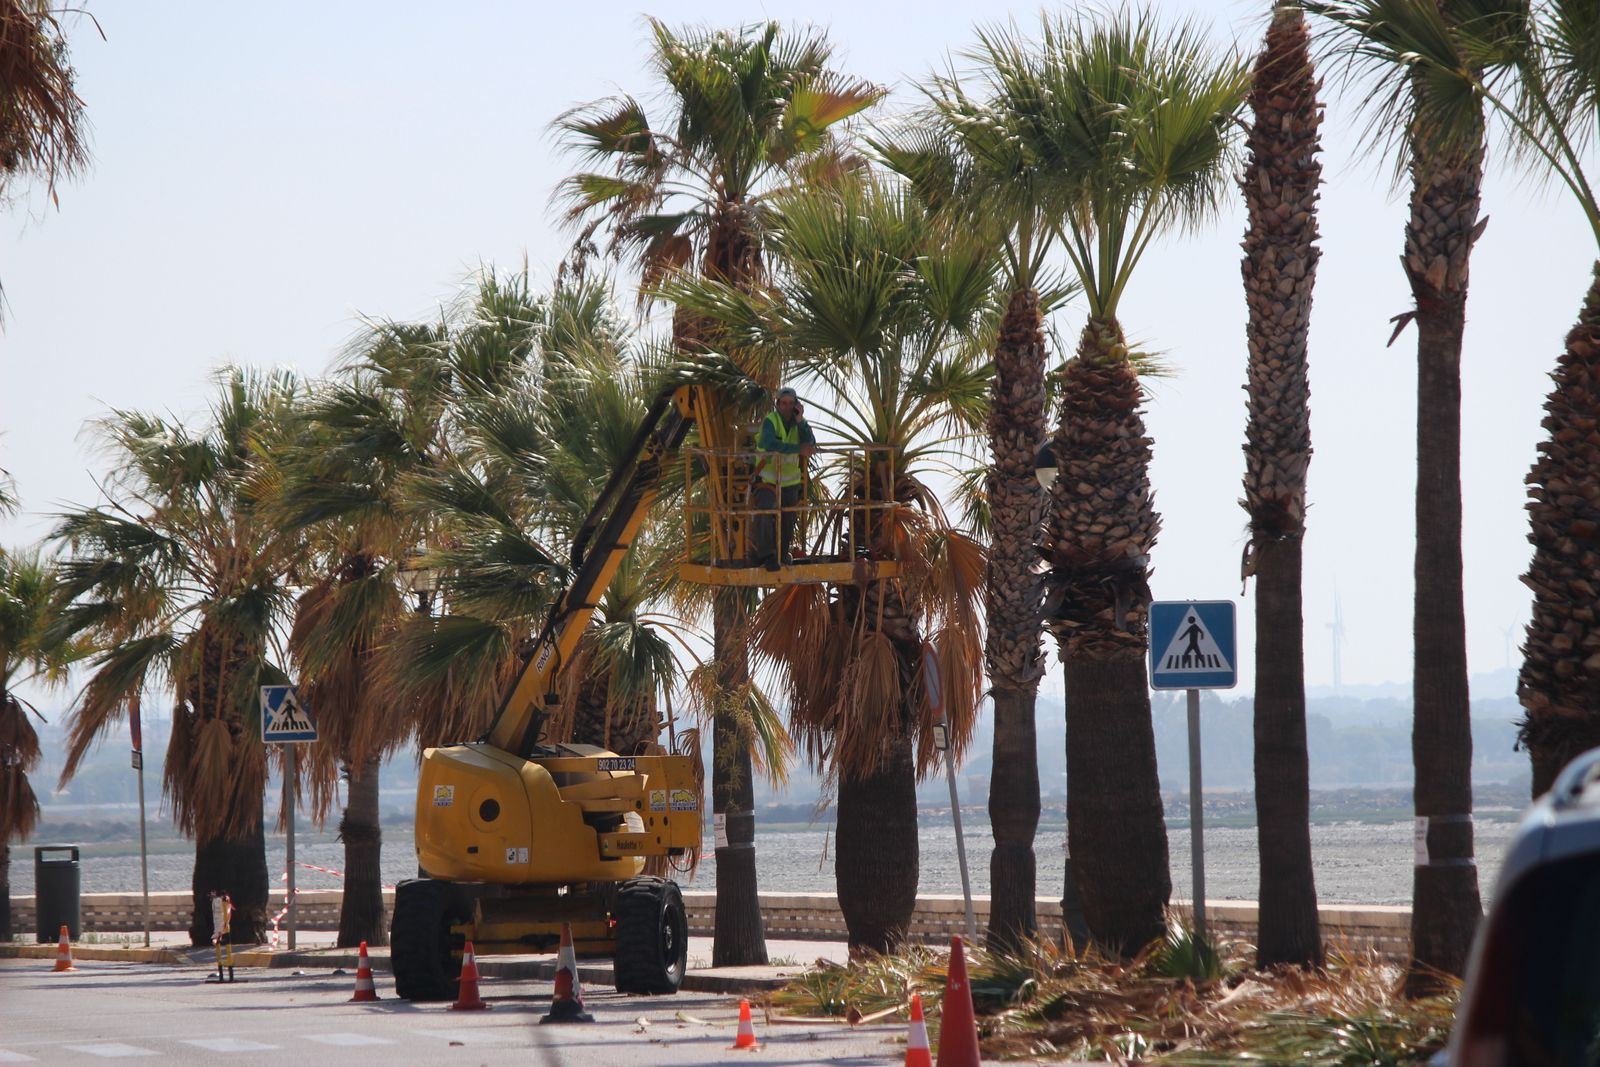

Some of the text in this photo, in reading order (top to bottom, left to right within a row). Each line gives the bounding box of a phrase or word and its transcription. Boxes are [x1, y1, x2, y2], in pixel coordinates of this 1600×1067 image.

[598, 759, 635, 770] 902 70 23 24
